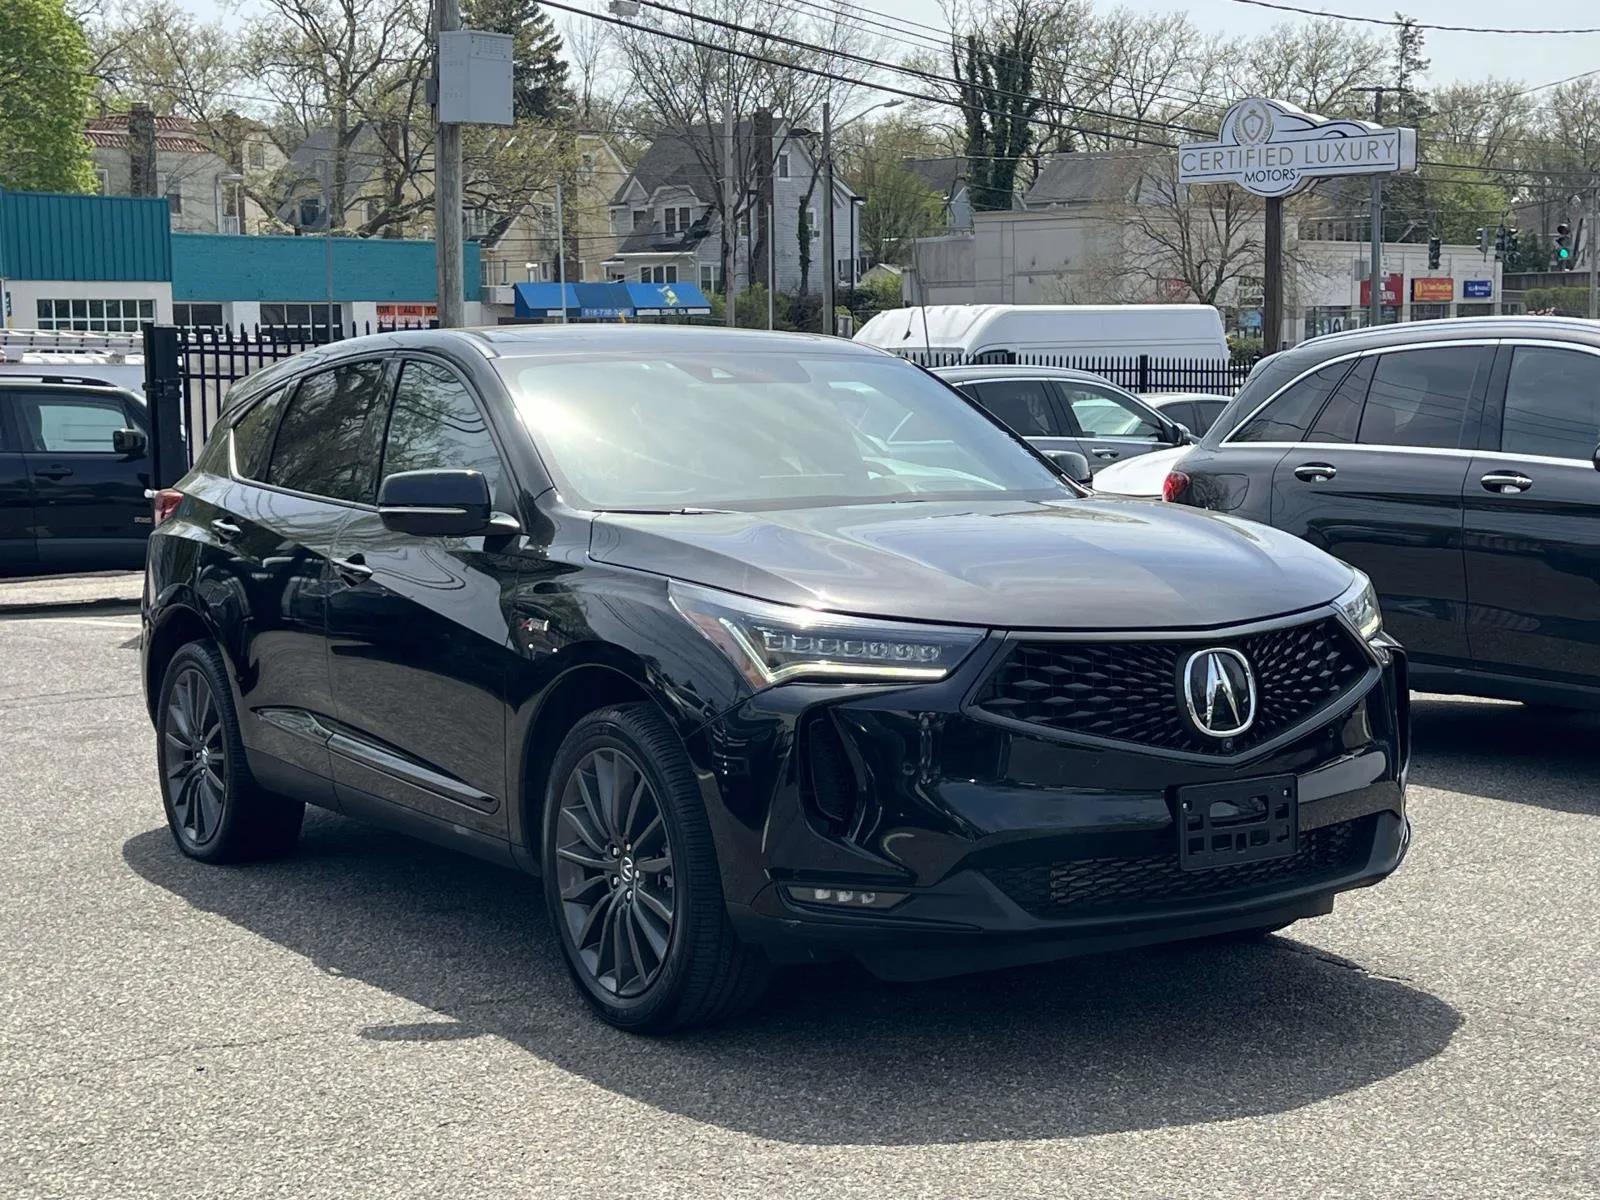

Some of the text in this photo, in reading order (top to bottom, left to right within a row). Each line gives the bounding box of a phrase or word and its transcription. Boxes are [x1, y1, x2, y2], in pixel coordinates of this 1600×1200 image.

[1181, 138, 1396, 172] CERTIFIED LUXURY
[1244, 168, 1296, 183] MOTORS
